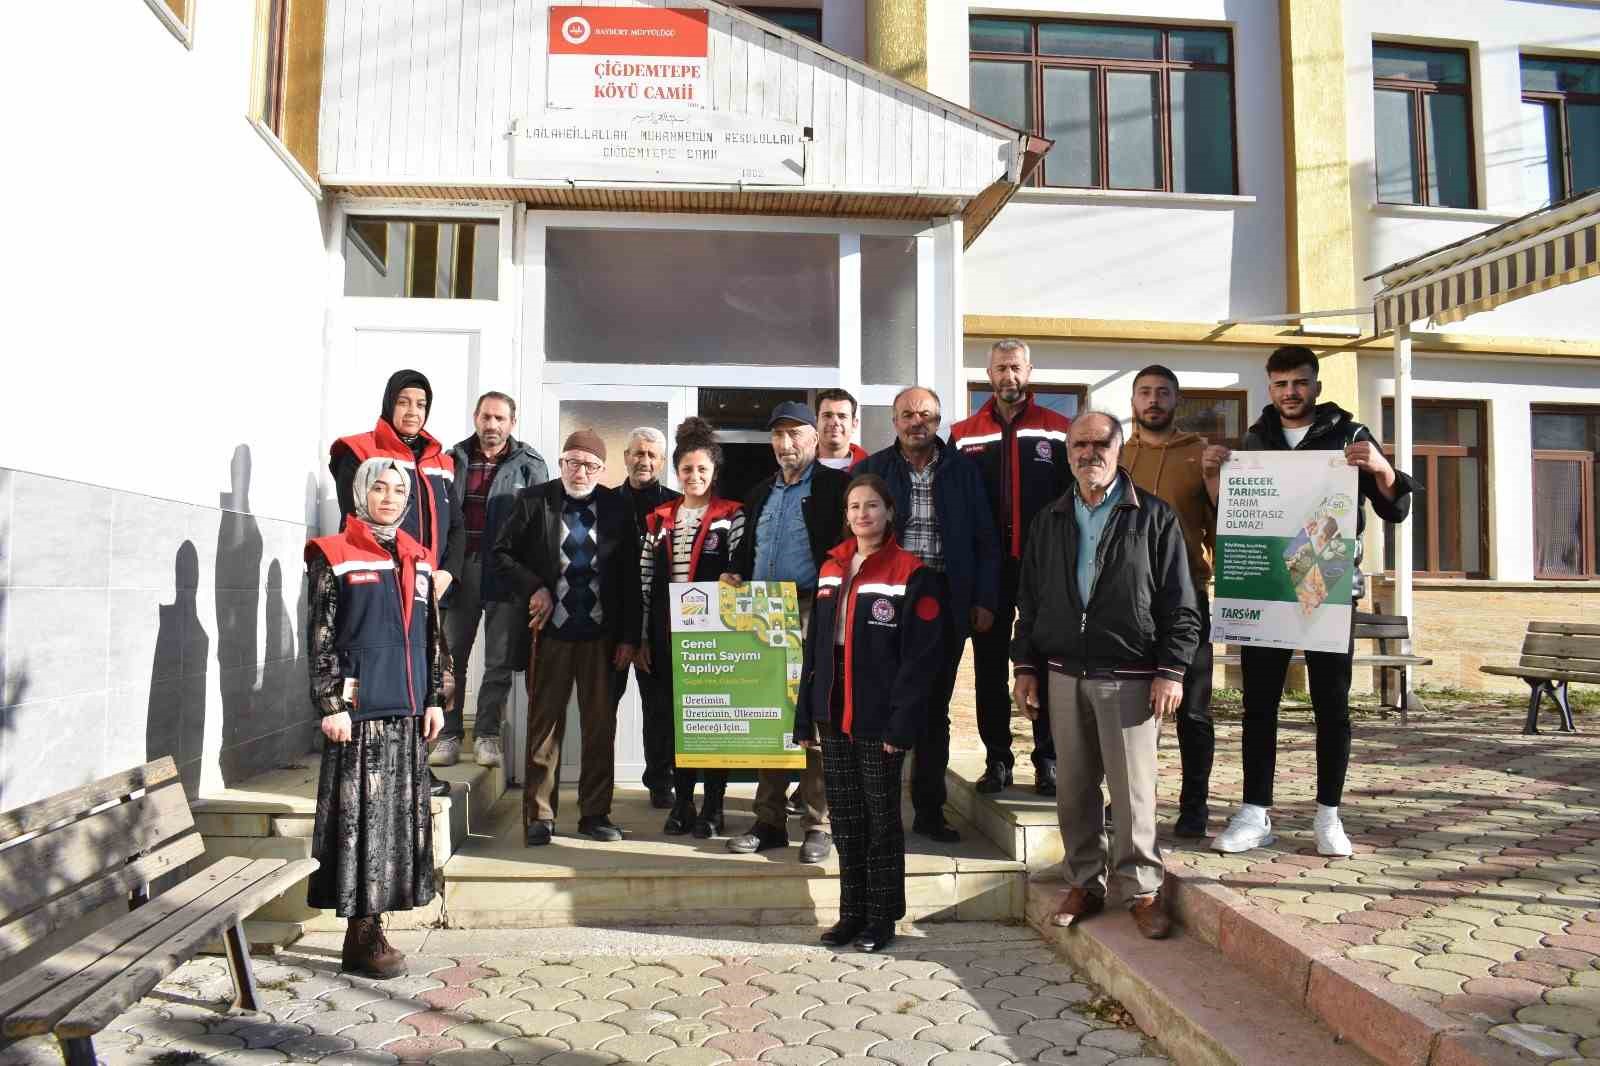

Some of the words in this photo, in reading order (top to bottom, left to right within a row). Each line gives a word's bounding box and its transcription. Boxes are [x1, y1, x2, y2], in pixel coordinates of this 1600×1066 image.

[594, 60, 701, 79] ÇİĞDEMTEPE
[594, 82, 639, 99] KÖYÜ
[644, 84, 694, 100] CAMİİ
[1228, 477, 1273, 486] GELECEK
[1228, 487, 1280, 497] TARIMSIZ.
[1228, 498, 1258, 507] TARIM
[1225, 520, 1263, 529] OLMAZ!
[681, 639, 717, 649] Genel
[681, 651, 717, 661] Tarım
[719, 651, 761, 663] Sayımı
[682, 663, 736, 675] Yapılıyor
[734, 708, 778, 719] Ülkemizin
[686, 721, 722, 733] Geleceği
